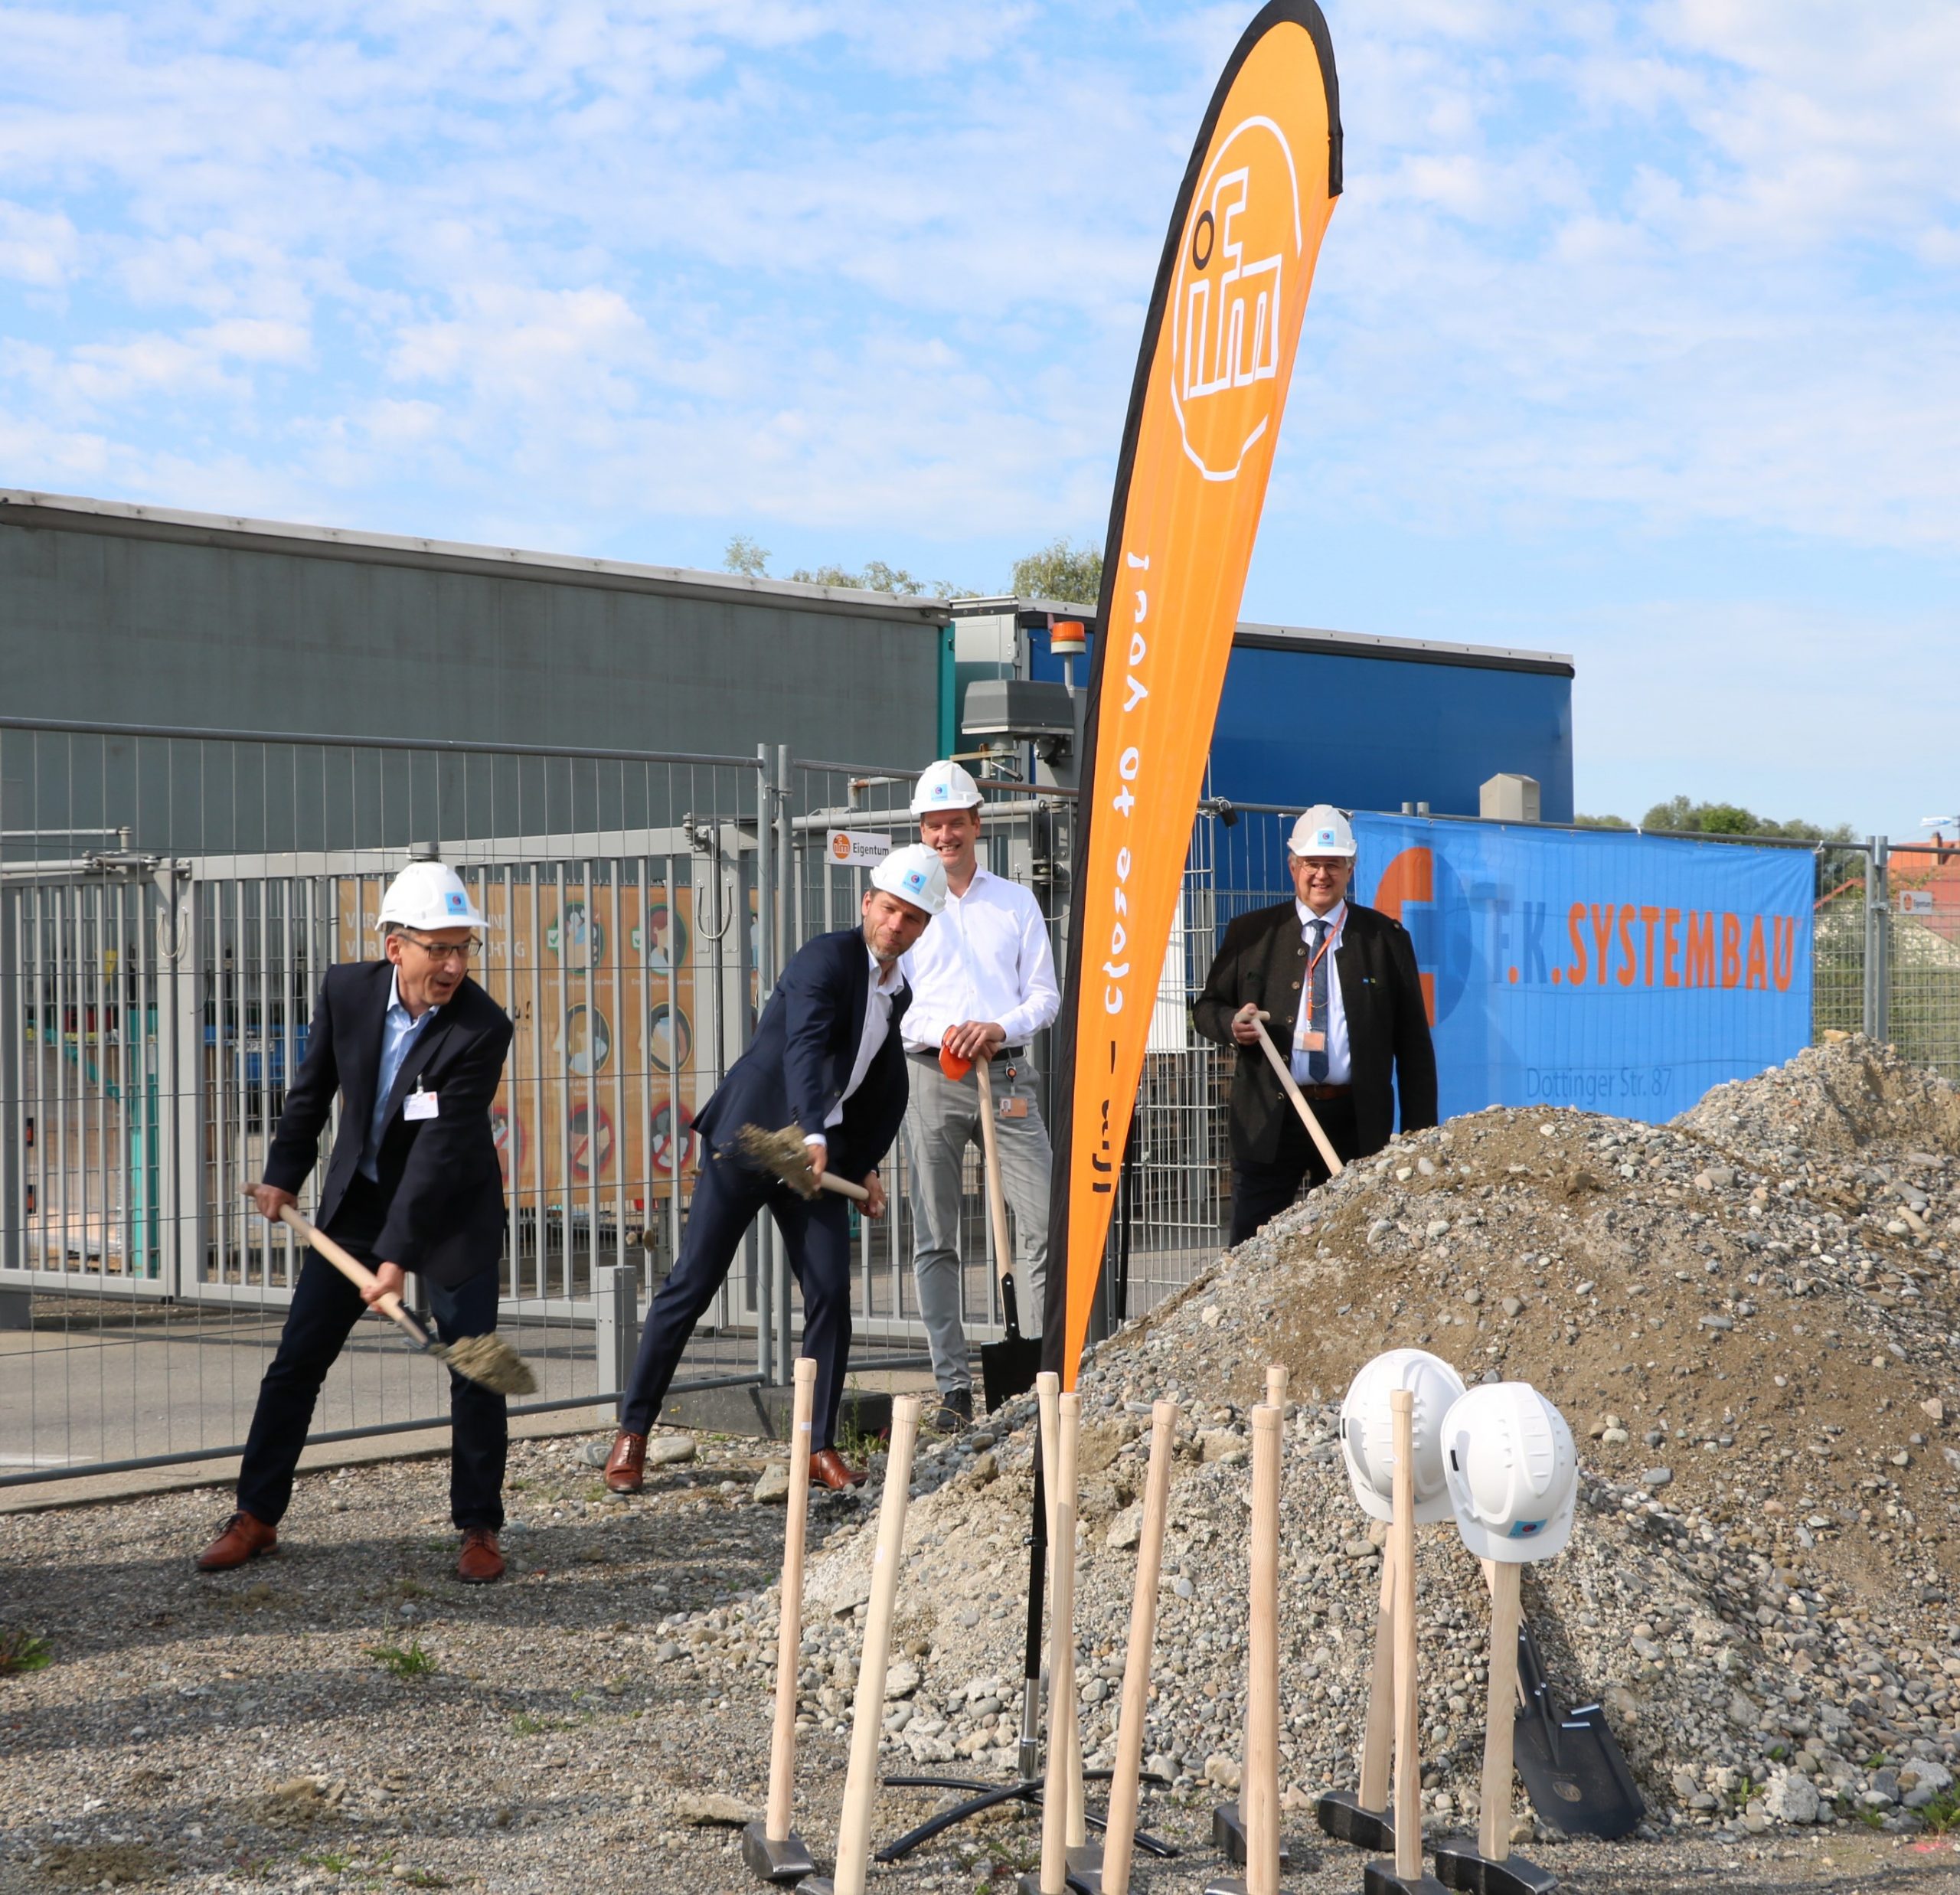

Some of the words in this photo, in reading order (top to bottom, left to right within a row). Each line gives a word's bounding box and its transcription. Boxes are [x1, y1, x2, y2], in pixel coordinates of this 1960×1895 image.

[1123, 551, 1149, 712] you!
[1112, 747, 1138, 818] to
[853, 842, 889, 857] Eigentum
[1102, 846, 1130, 1014] close
[1527, 1067, 1615, 1105] Dottinger
[1620, 1067, 1645, 1097] Str.
[1651, 1067, 1671, 1096] 87
